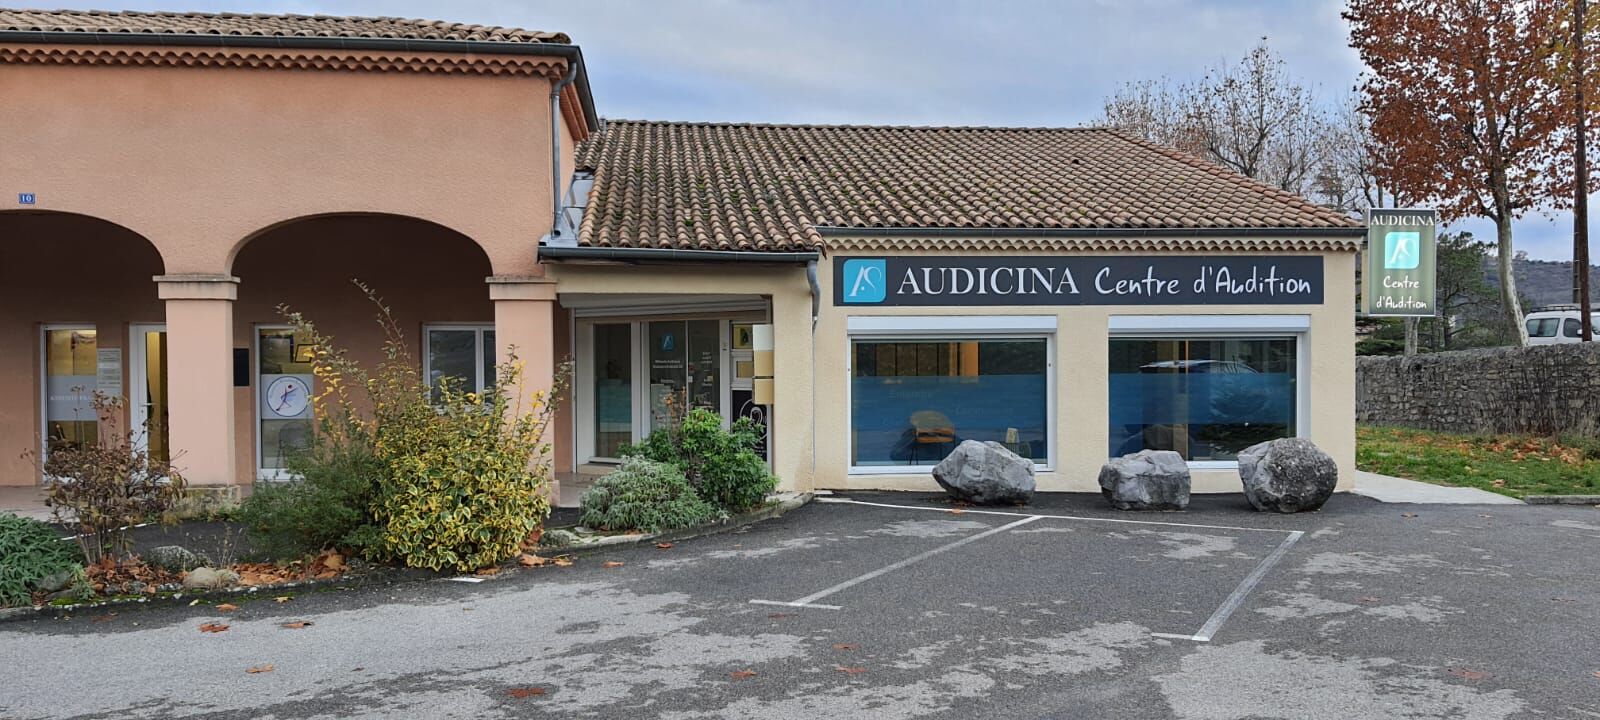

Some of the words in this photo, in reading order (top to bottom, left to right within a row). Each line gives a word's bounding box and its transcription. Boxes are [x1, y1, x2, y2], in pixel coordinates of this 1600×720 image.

[22, 194, 32, 202] 10
[1371, 215, 1434, 226] AUDICINA
[896, 266, 1080, 295] AUDICINA
[1094, 265, 1180, 297] Centre
[1193, 265, 1311, 297] d'Audition
[1383, 275, 1420, 289] Centre
[1376, 295, 1427, 309] d'Audition
